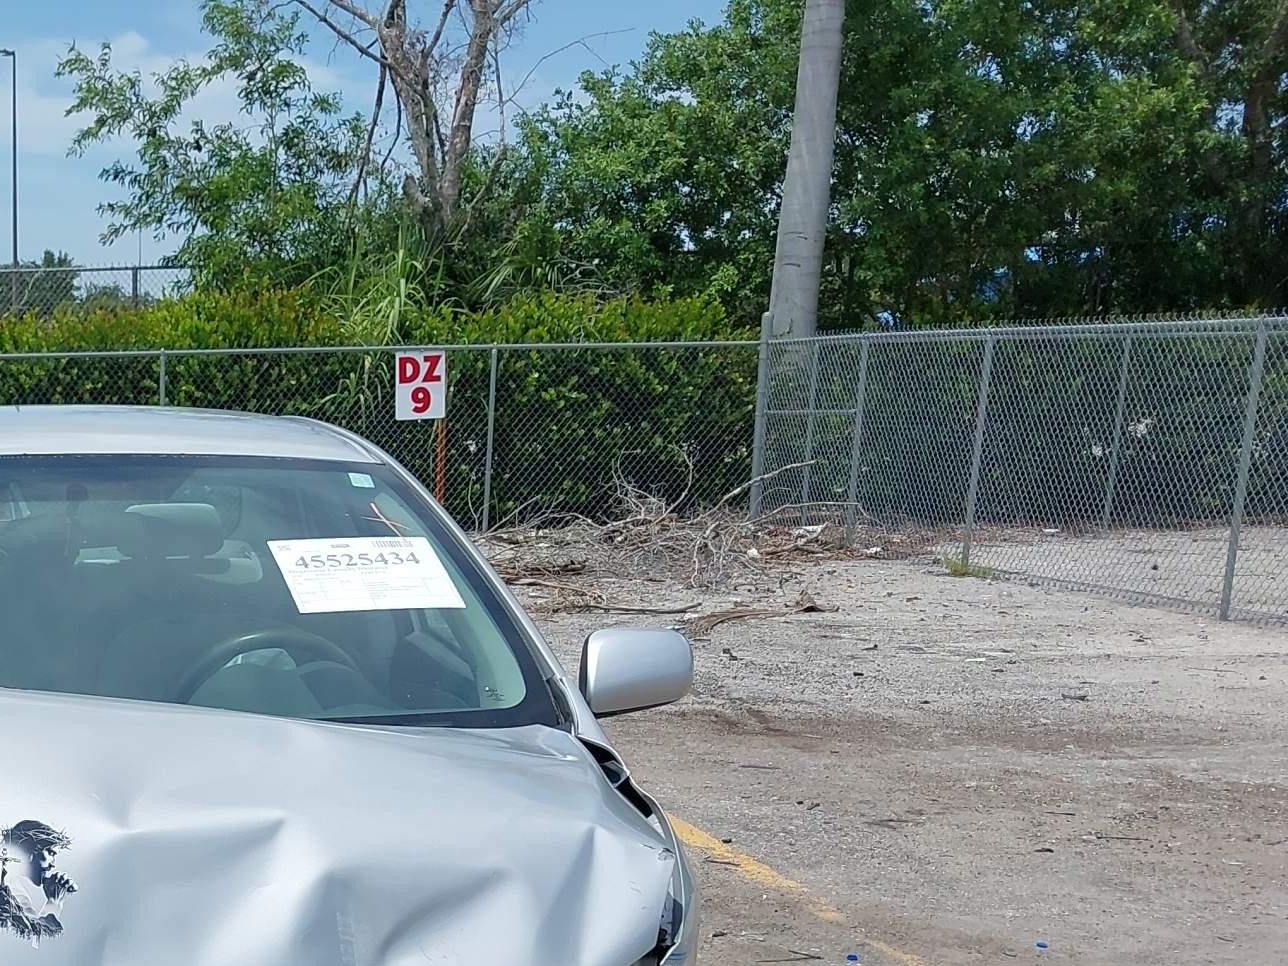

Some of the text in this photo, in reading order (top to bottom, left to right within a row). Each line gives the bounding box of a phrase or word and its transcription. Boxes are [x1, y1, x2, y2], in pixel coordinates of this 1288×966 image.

[398, 355, 442, 384] DZ
[410, 386, 431, 414] 9
[295, 551, 420, 569] 45525434
